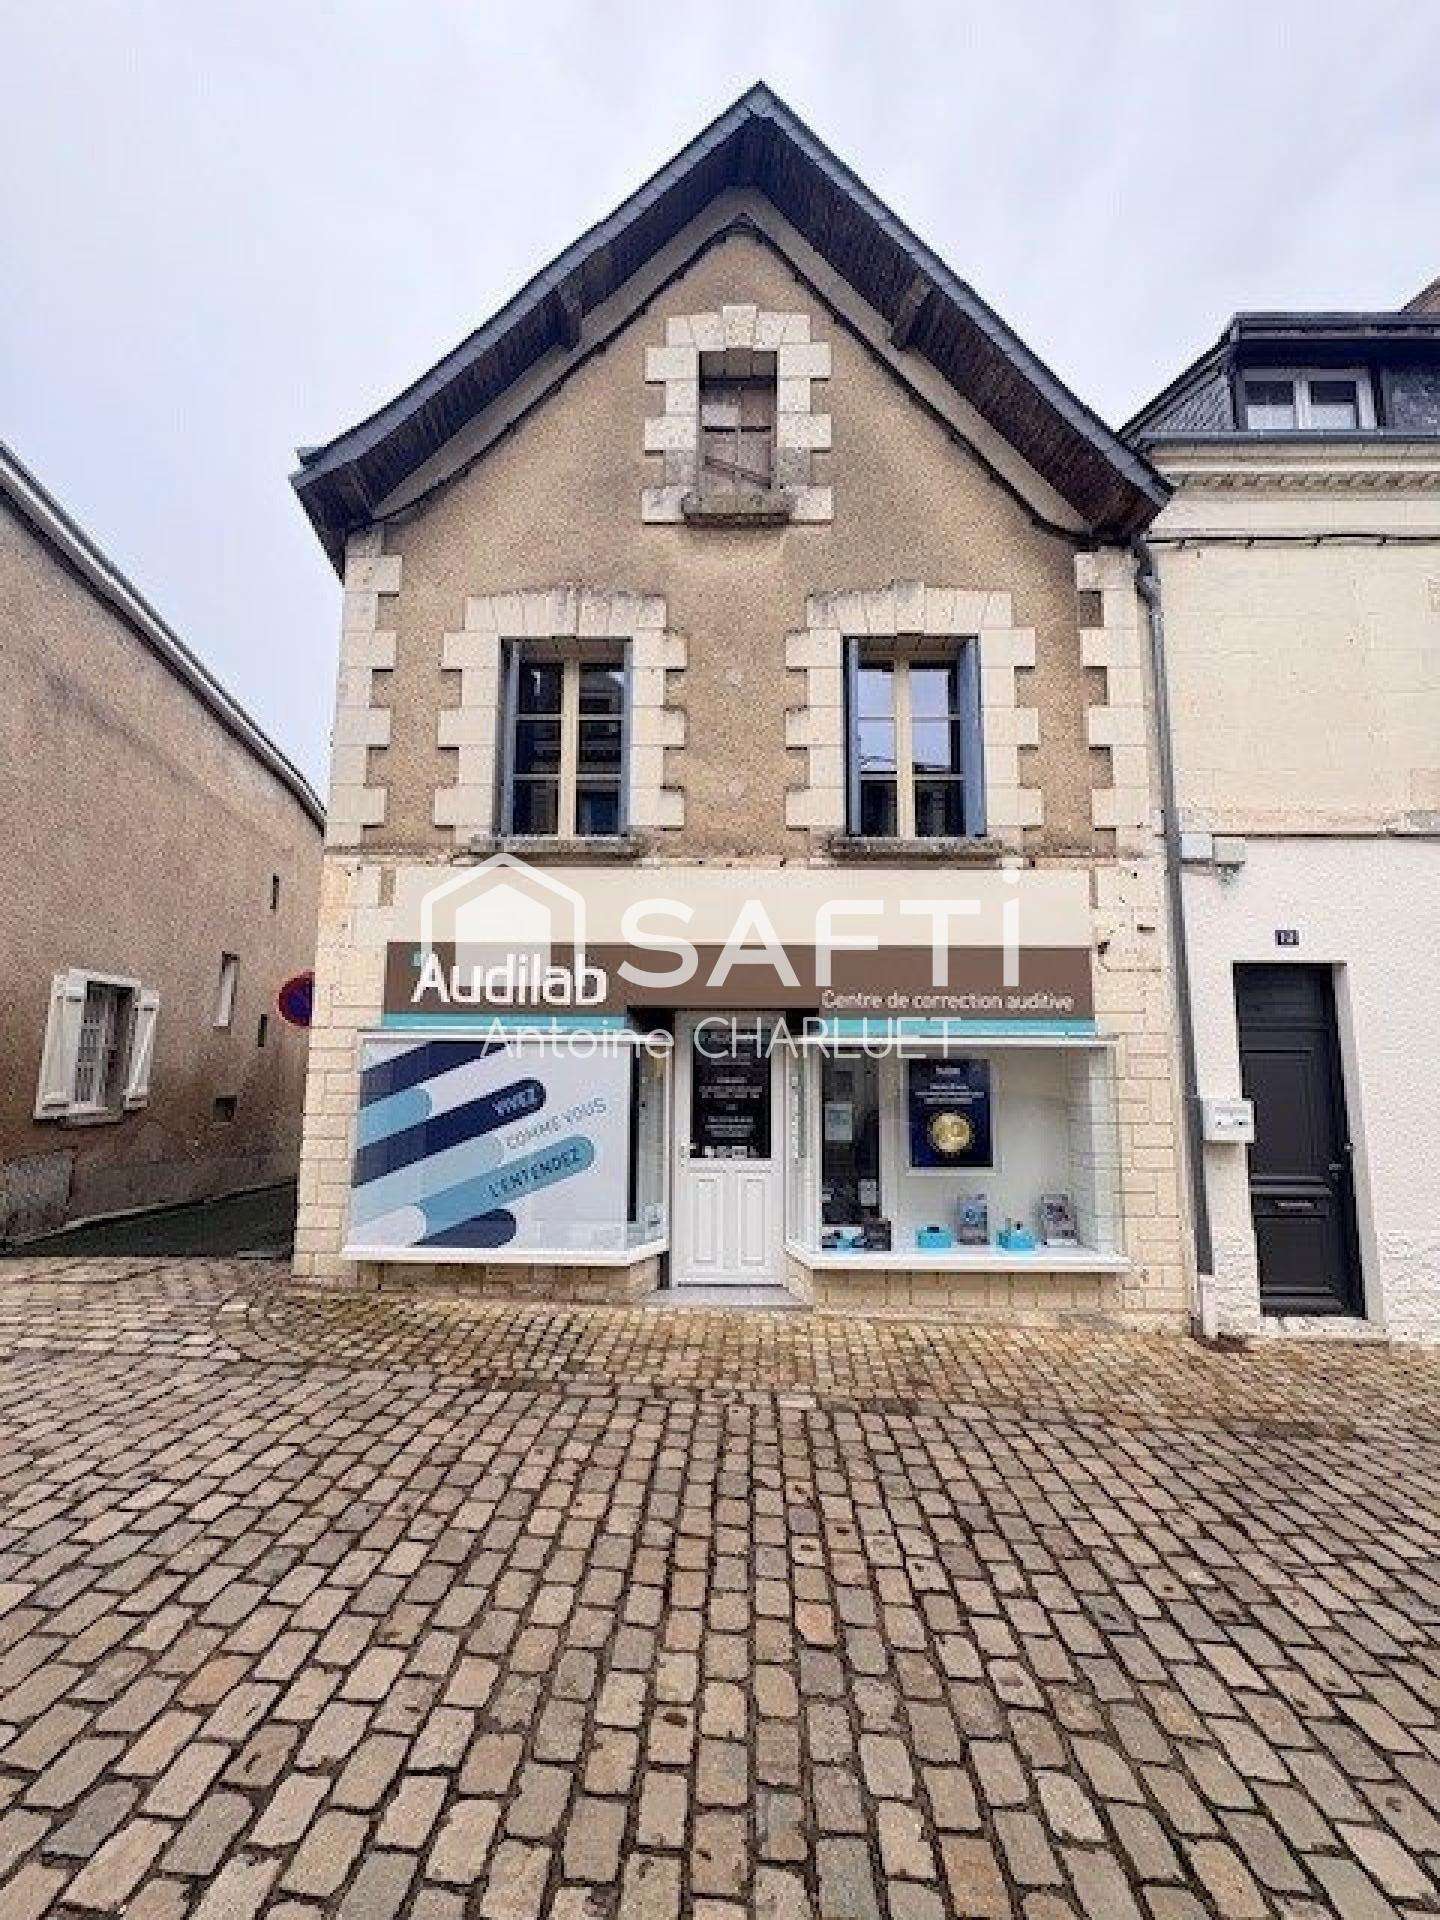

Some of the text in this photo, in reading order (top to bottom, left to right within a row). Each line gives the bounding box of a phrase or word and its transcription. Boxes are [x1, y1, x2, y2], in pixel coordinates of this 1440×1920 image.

[411, 952, 608, 1006] Audilab
[821, 988, 1075, 1011] Centre de correction auditive
[506, 1097, 607, 1149] COMME VOUS
